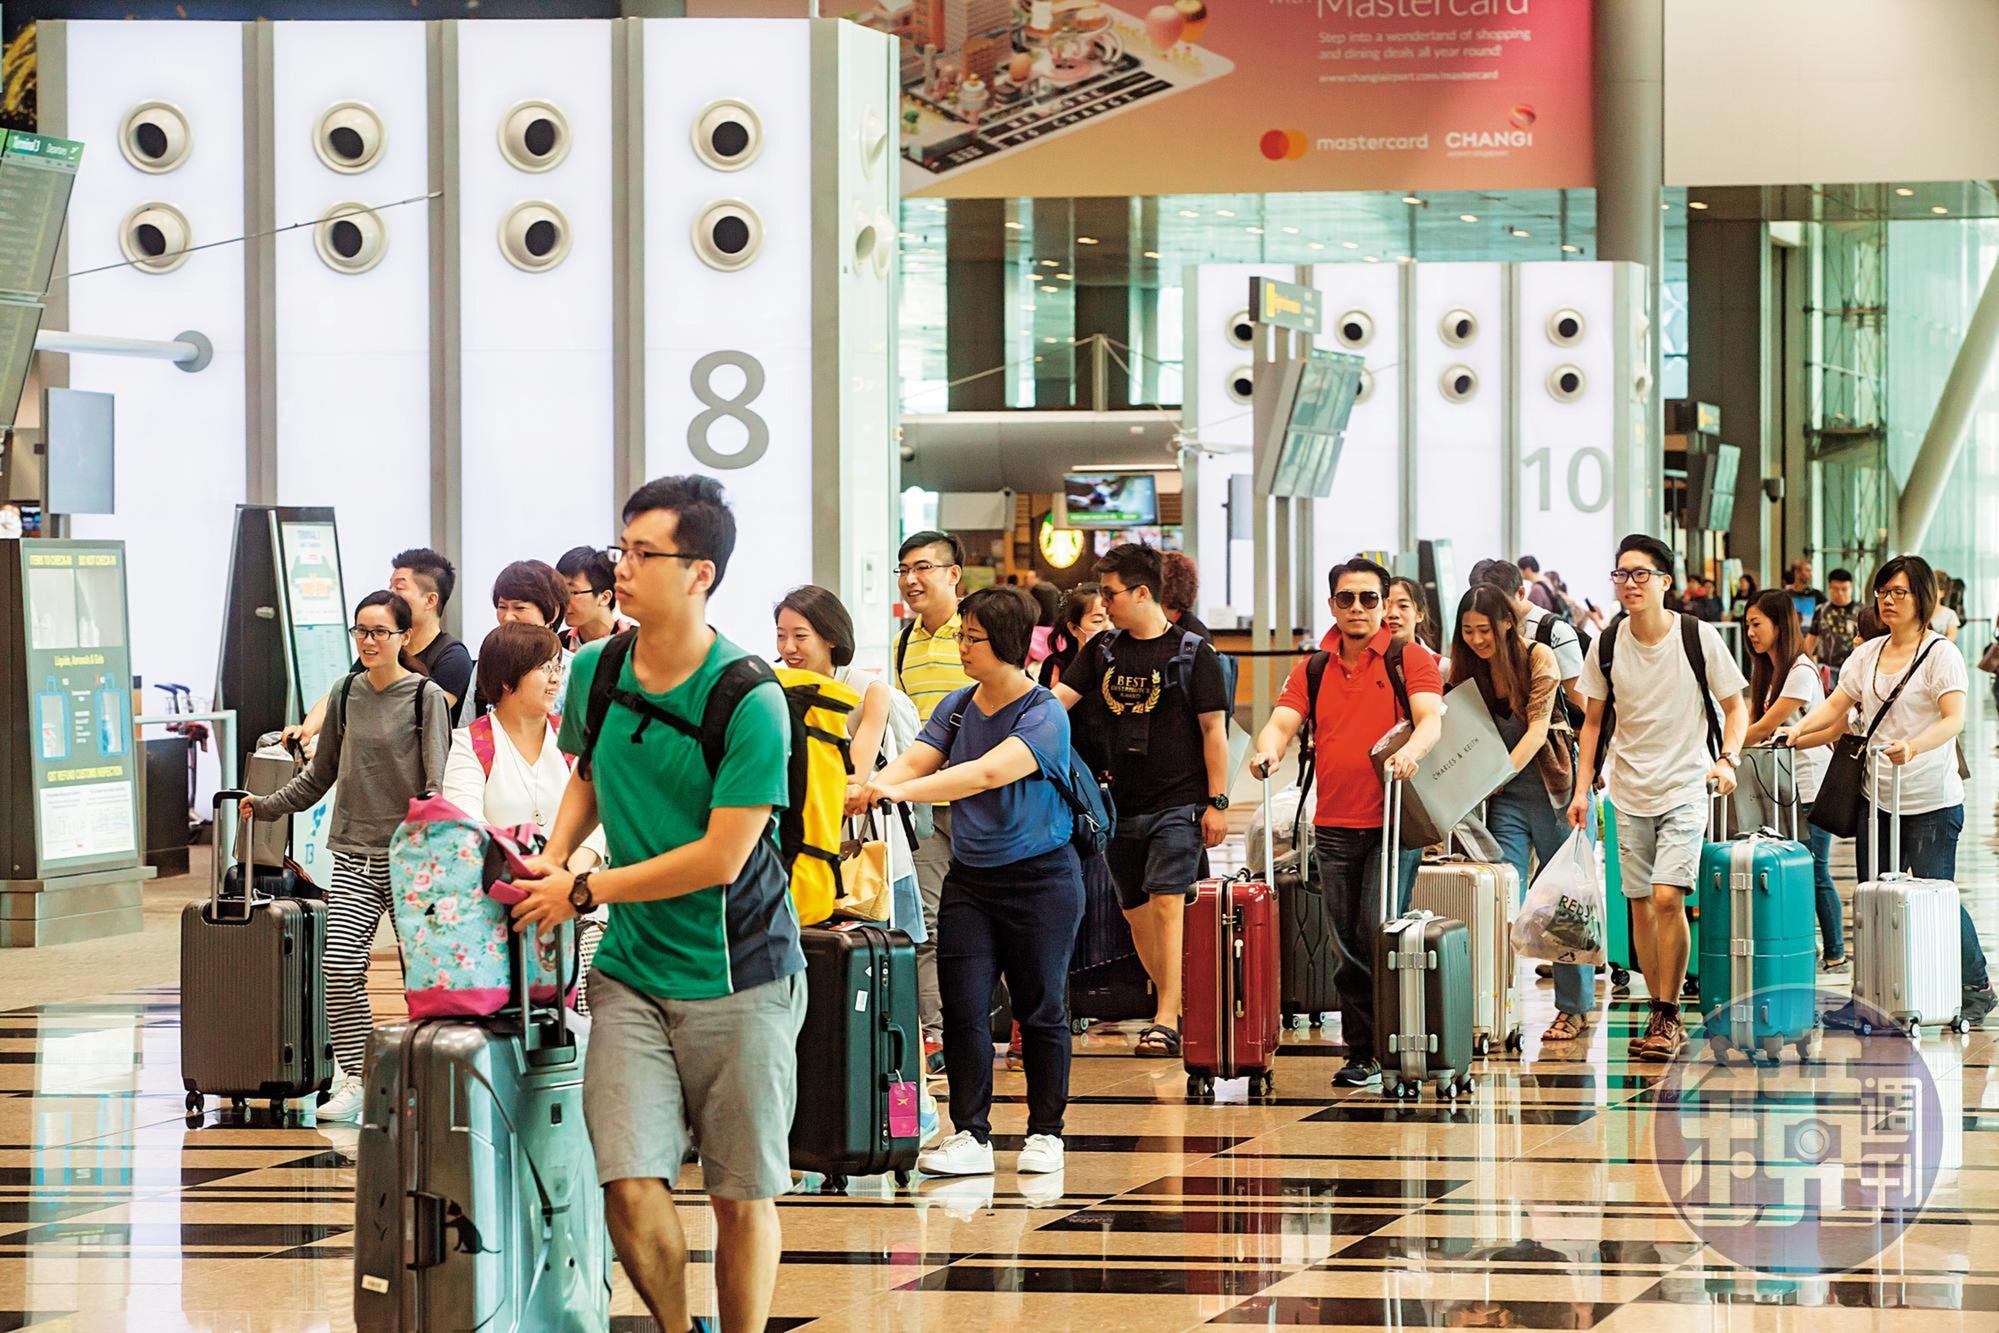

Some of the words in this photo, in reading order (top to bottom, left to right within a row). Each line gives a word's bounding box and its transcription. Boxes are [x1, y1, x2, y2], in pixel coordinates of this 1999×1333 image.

[1318, 31, 1346, 44] Step
[1349, 31, 1373, 42] into
[1375, 33, 1383, 42] a
[1386, 30, 1457, 43] wonderland
[1459, 28, 1473, 41] of
[1476, 28, 1532, 43] shopping
[1318, 48, 1342, 60] and
[1344, 48, 1381, 62] dining
[1383, 47, 1415, 59] deals
[1417, 45, 1431, 58] all
[1434, 47, 1459, 60] year
[1316, 132, 1429, 151] mastercard
[1445, 130, 1534, 149] CHANGI
[687, 349, 769, 470] 8
[1522, 446, 1612, 513] 10
[1117, 675, 1148, 688] BEST
[1432, 757, 1457, 781] CHARLES
[1463, 737, 1480, 753] KEITH
